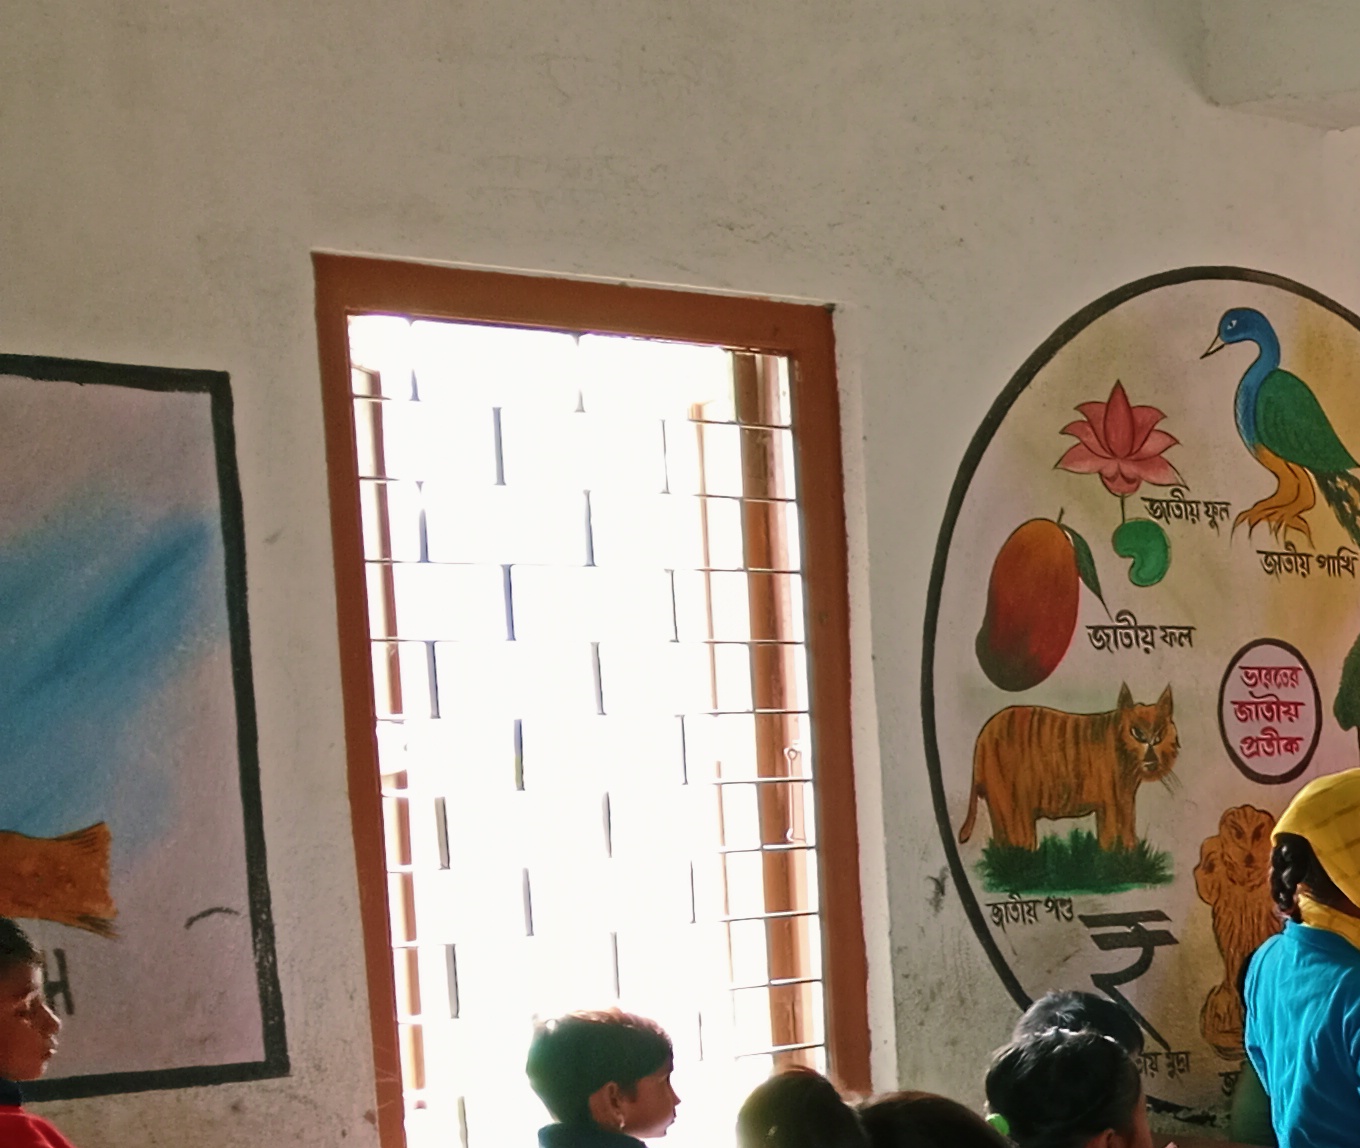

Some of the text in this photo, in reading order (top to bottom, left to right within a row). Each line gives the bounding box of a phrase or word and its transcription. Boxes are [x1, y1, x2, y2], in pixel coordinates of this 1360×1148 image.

[1203, 501, 1231, 537] ফুল
[1316, 546, 1359, 578] পাখি
[1160, 625, 1196, 648] ফল
[1239, 666, 1303, 688] ভারতের
[1240, 726, 1304, 758] প্রতীক
